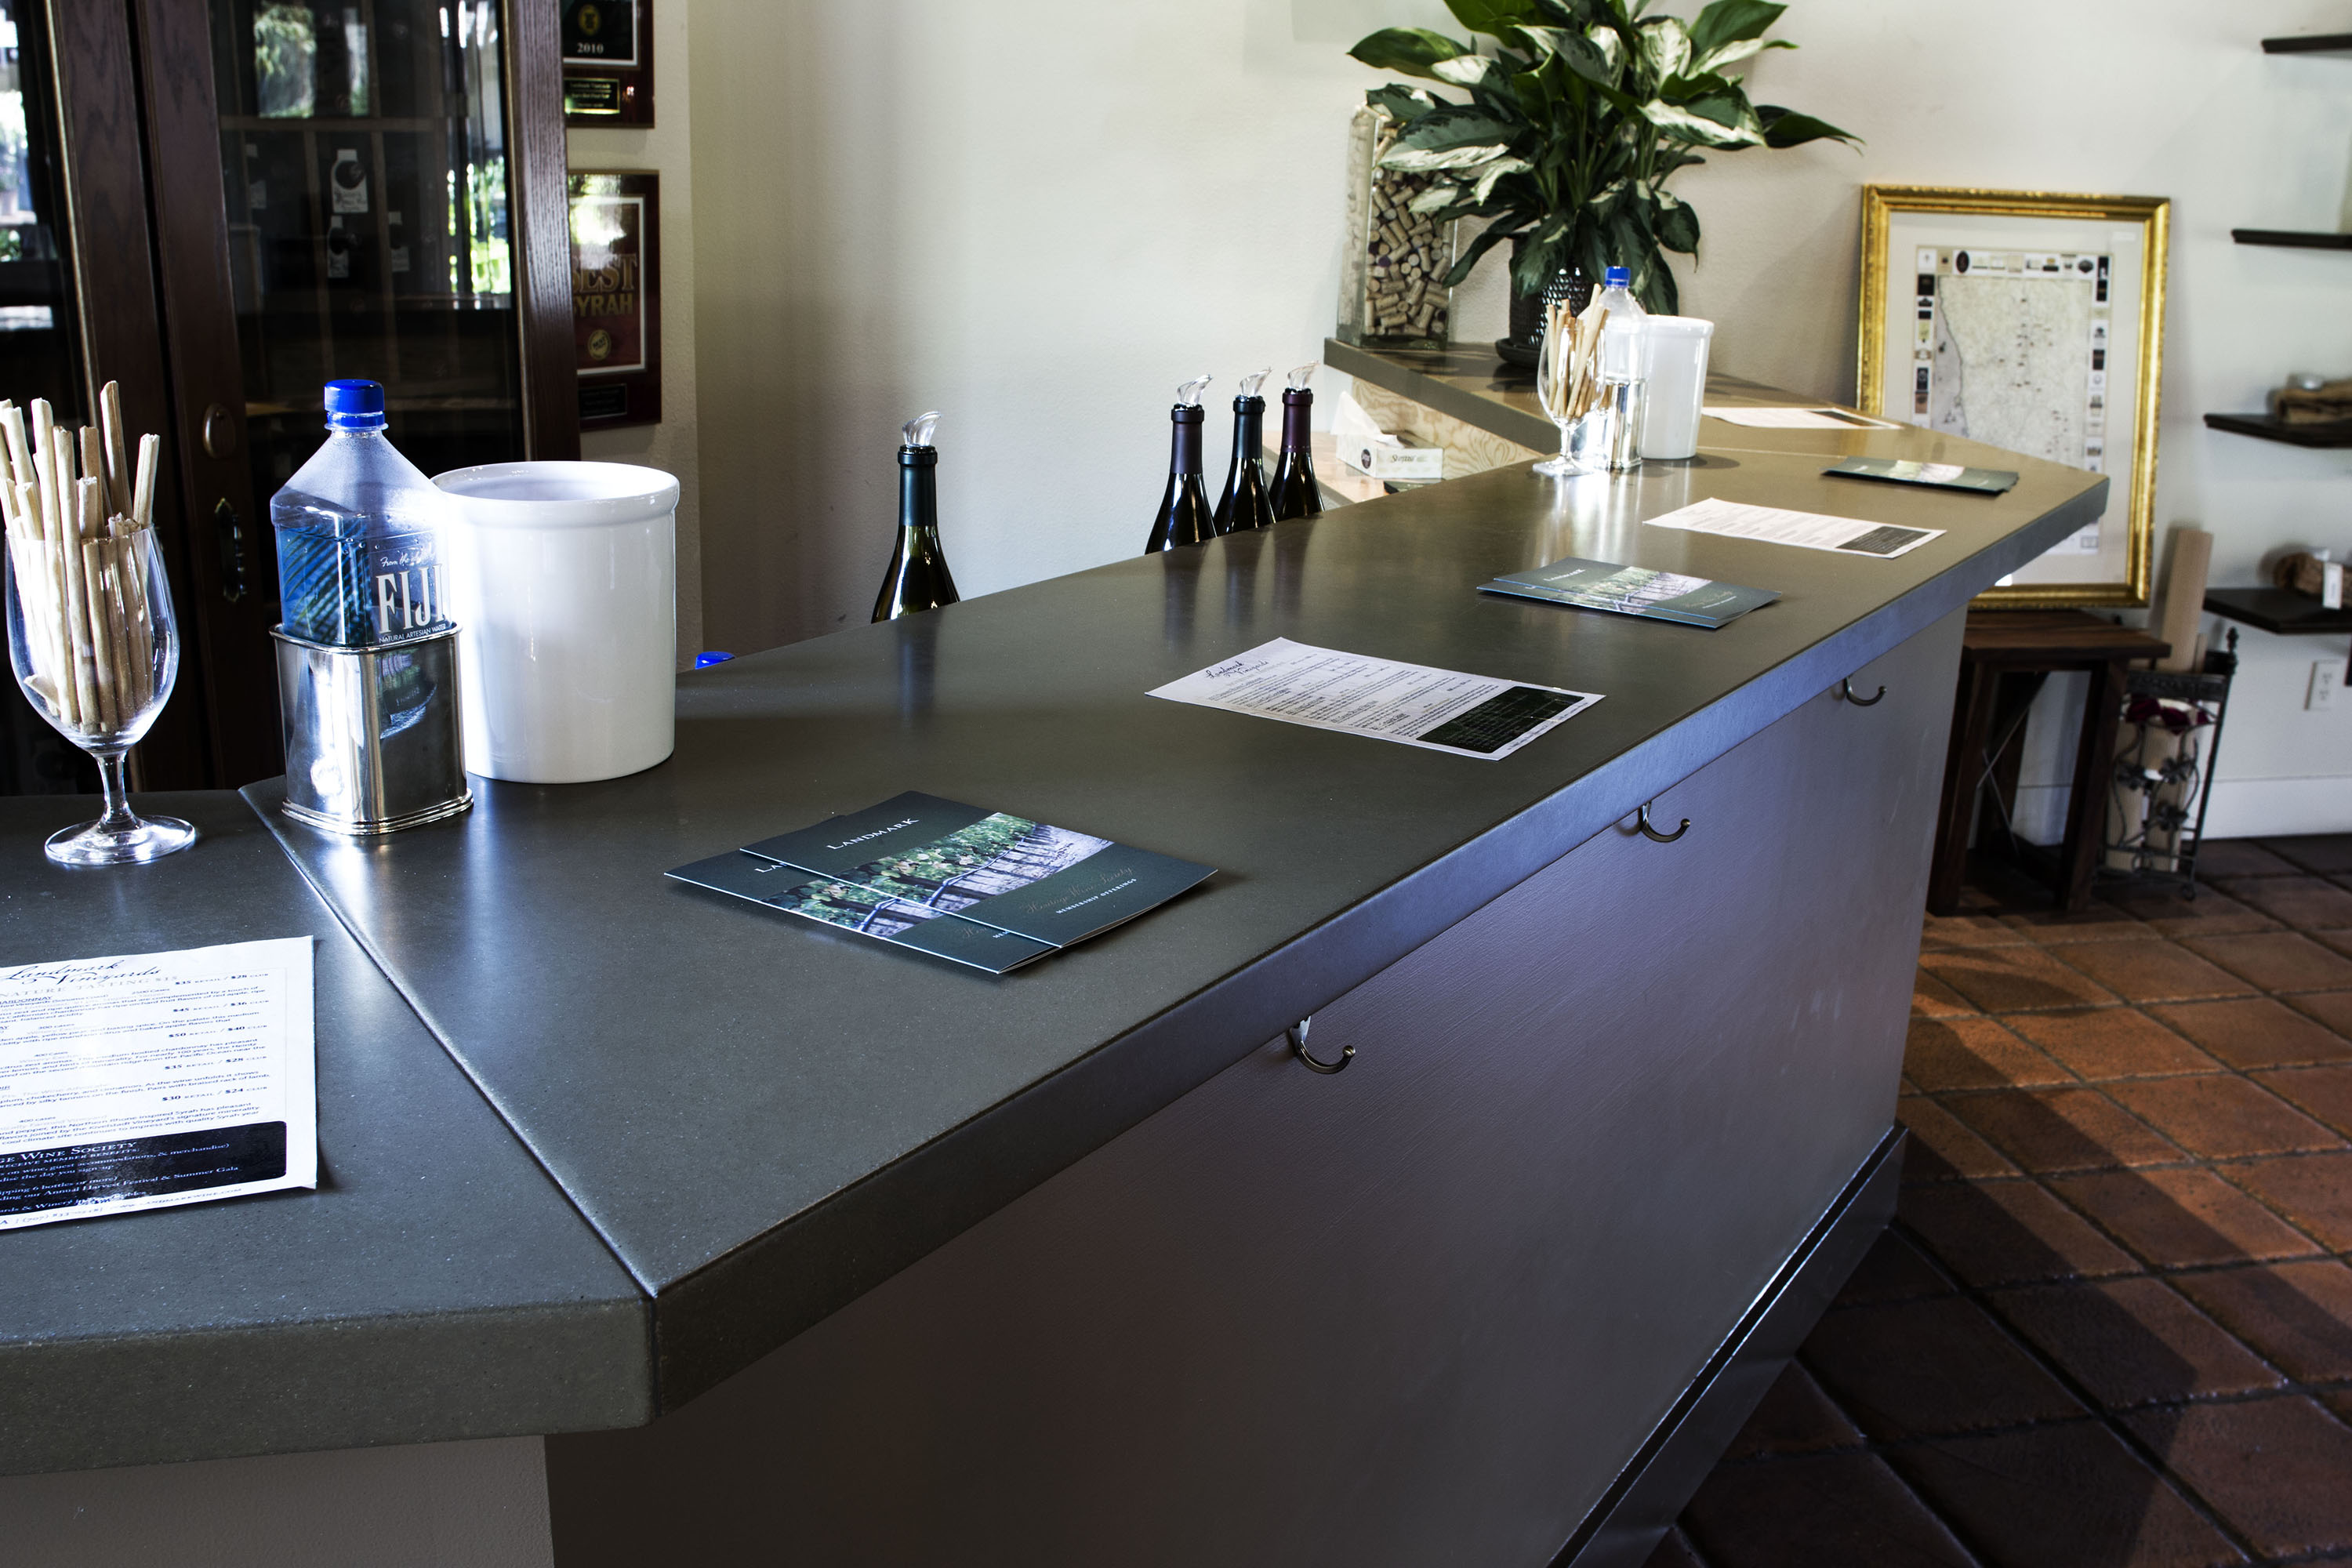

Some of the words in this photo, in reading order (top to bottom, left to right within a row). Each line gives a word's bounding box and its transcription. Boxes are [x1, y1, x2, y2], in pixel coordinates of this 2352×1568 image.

[577, 42, 604, 54] 2010
[376, 564, 445, 633] FIJI
[379, 633, 405, 644] NATURAL
[407, 628, 431, 639] ARTESIAN
[1206, 659, 1244, 679] Landmark
[826, 818, 920, 850] LANDMARK
[1055, 895, 1099, 914] MEMBERSHIP
[1100, 878, 1138, 897] OFFERINGS
[5, 959, 125, 981] Landmark
[39, 965, 162, 985] Vineyards
[20, 1151, 65, 1160] WINE
[71, 1142, 136, 1154] SOCIETY
[43, 1154, 87, 1163] MEMBER
